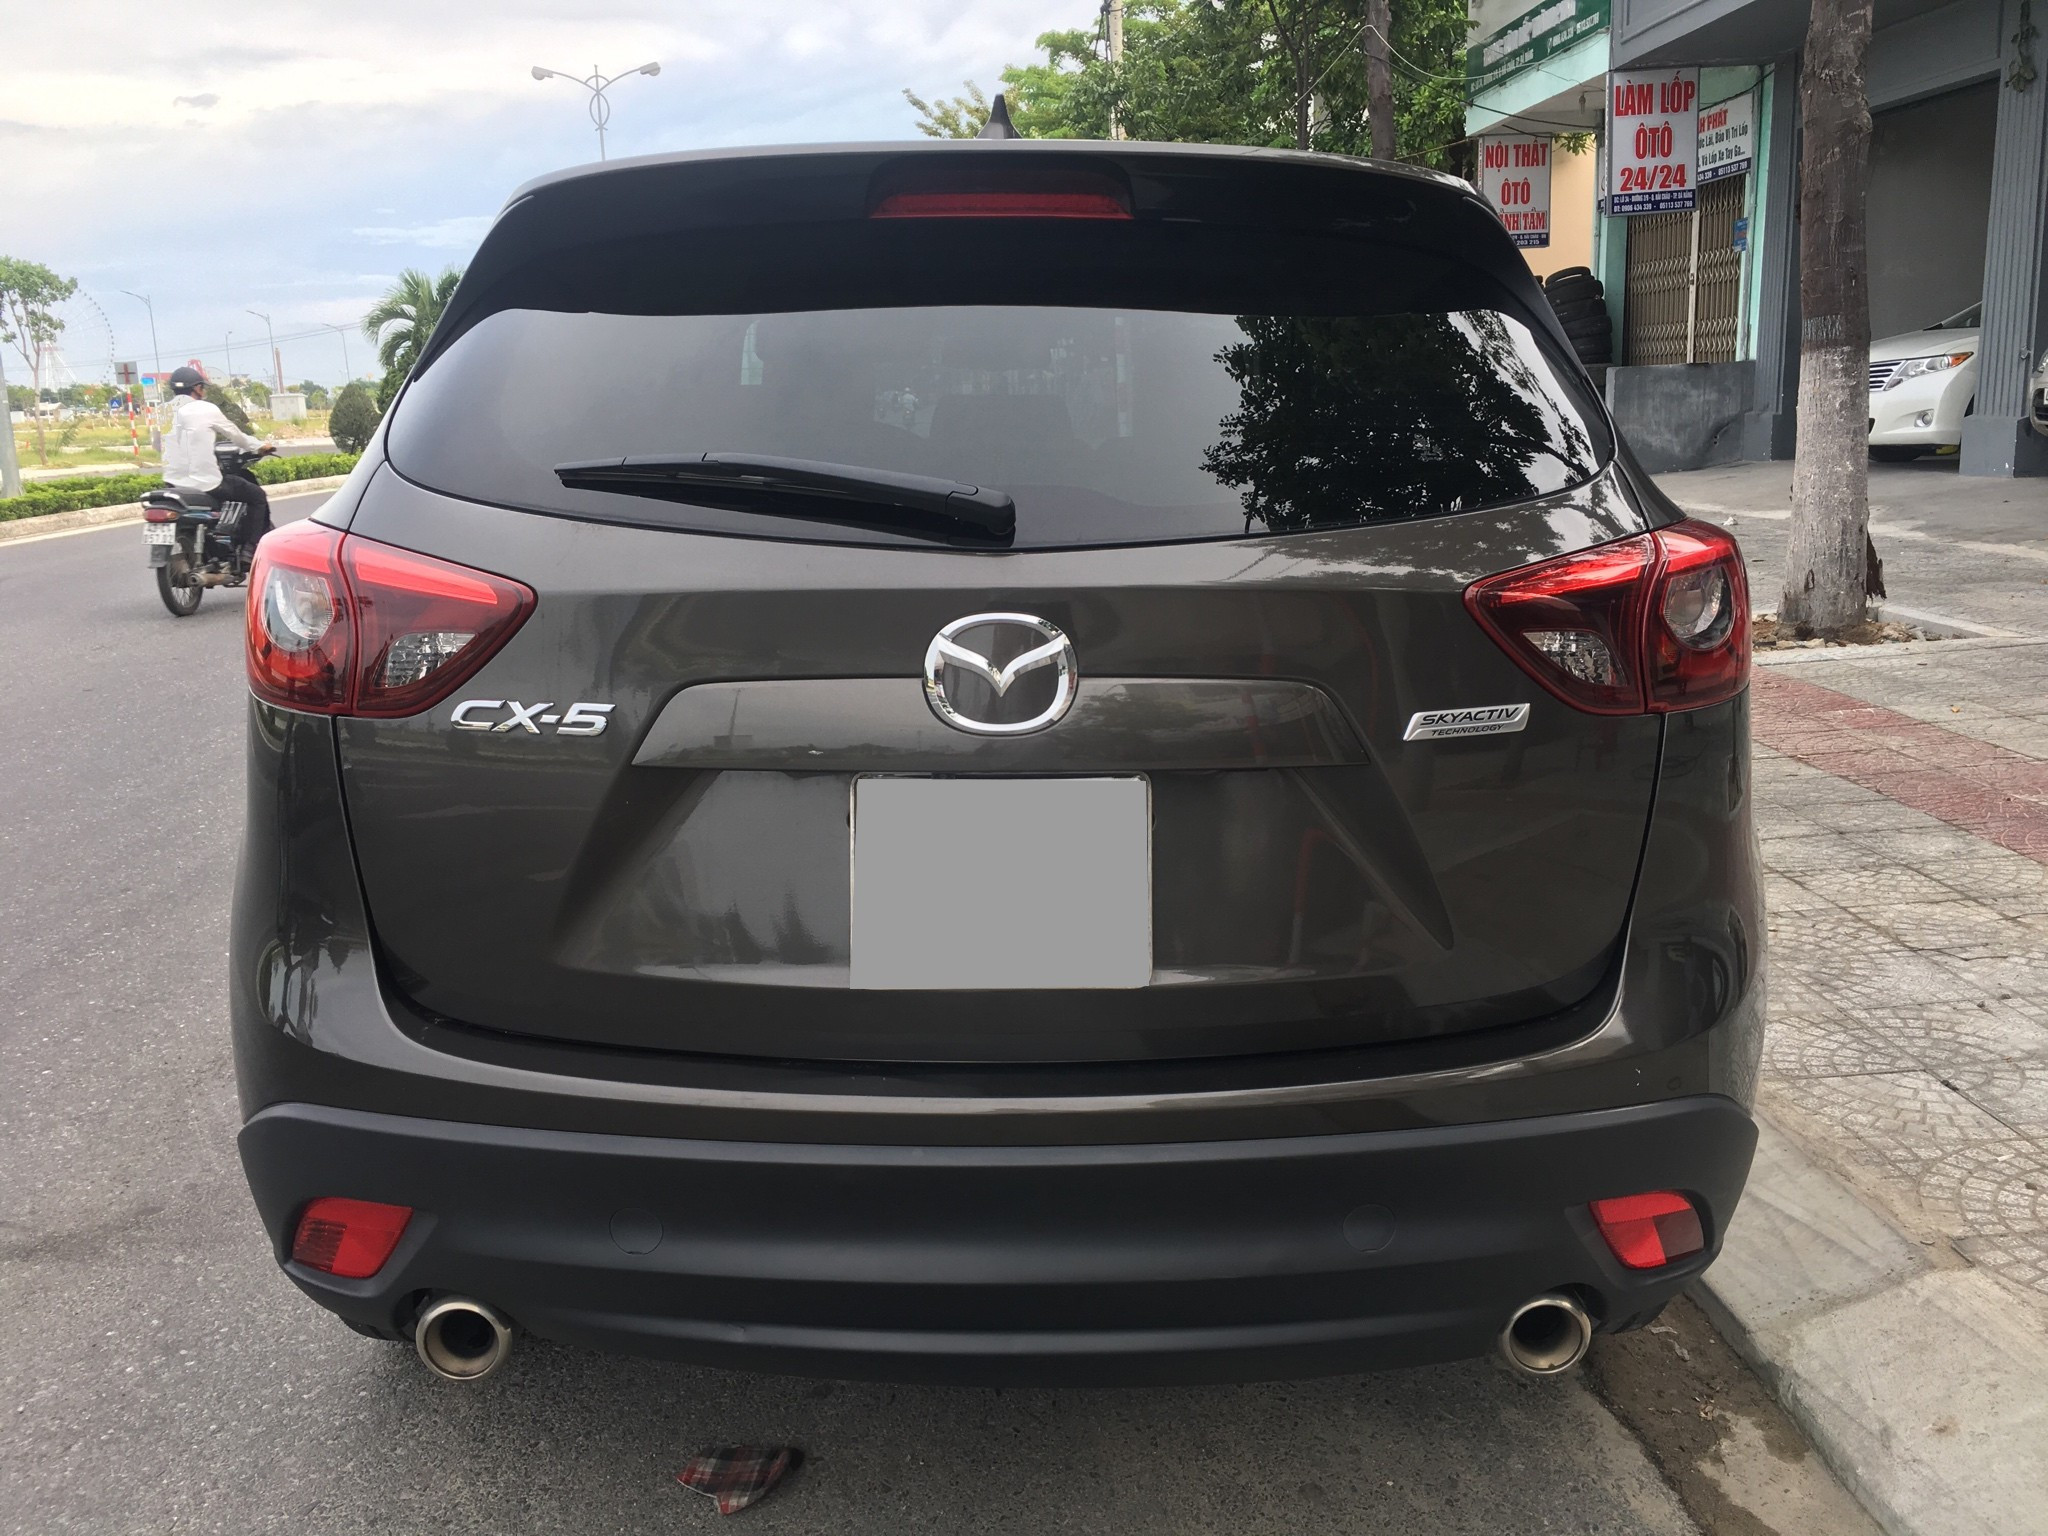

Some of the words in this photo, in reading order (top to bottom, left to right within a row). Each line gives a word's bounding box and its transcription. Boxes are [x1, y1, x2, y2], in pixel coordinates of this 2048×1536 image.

[1615, 80, 1653, 117] LÀM
[1660, 70, 1696, 114] LỐP
[1635, 120, 1673, 160] ÔTÔ
[1485, 140, 1509, 173] NỘI
[1501, 177, 1531, 206] ÔTÔ
[1620, 163, 1687, 192] 24/24
[451, 699, 616, 737] CX-5
[1420, 706, 1520, 726] SKYACTIV
[1430, 723, 1505, 737] TECHNOLOGY
